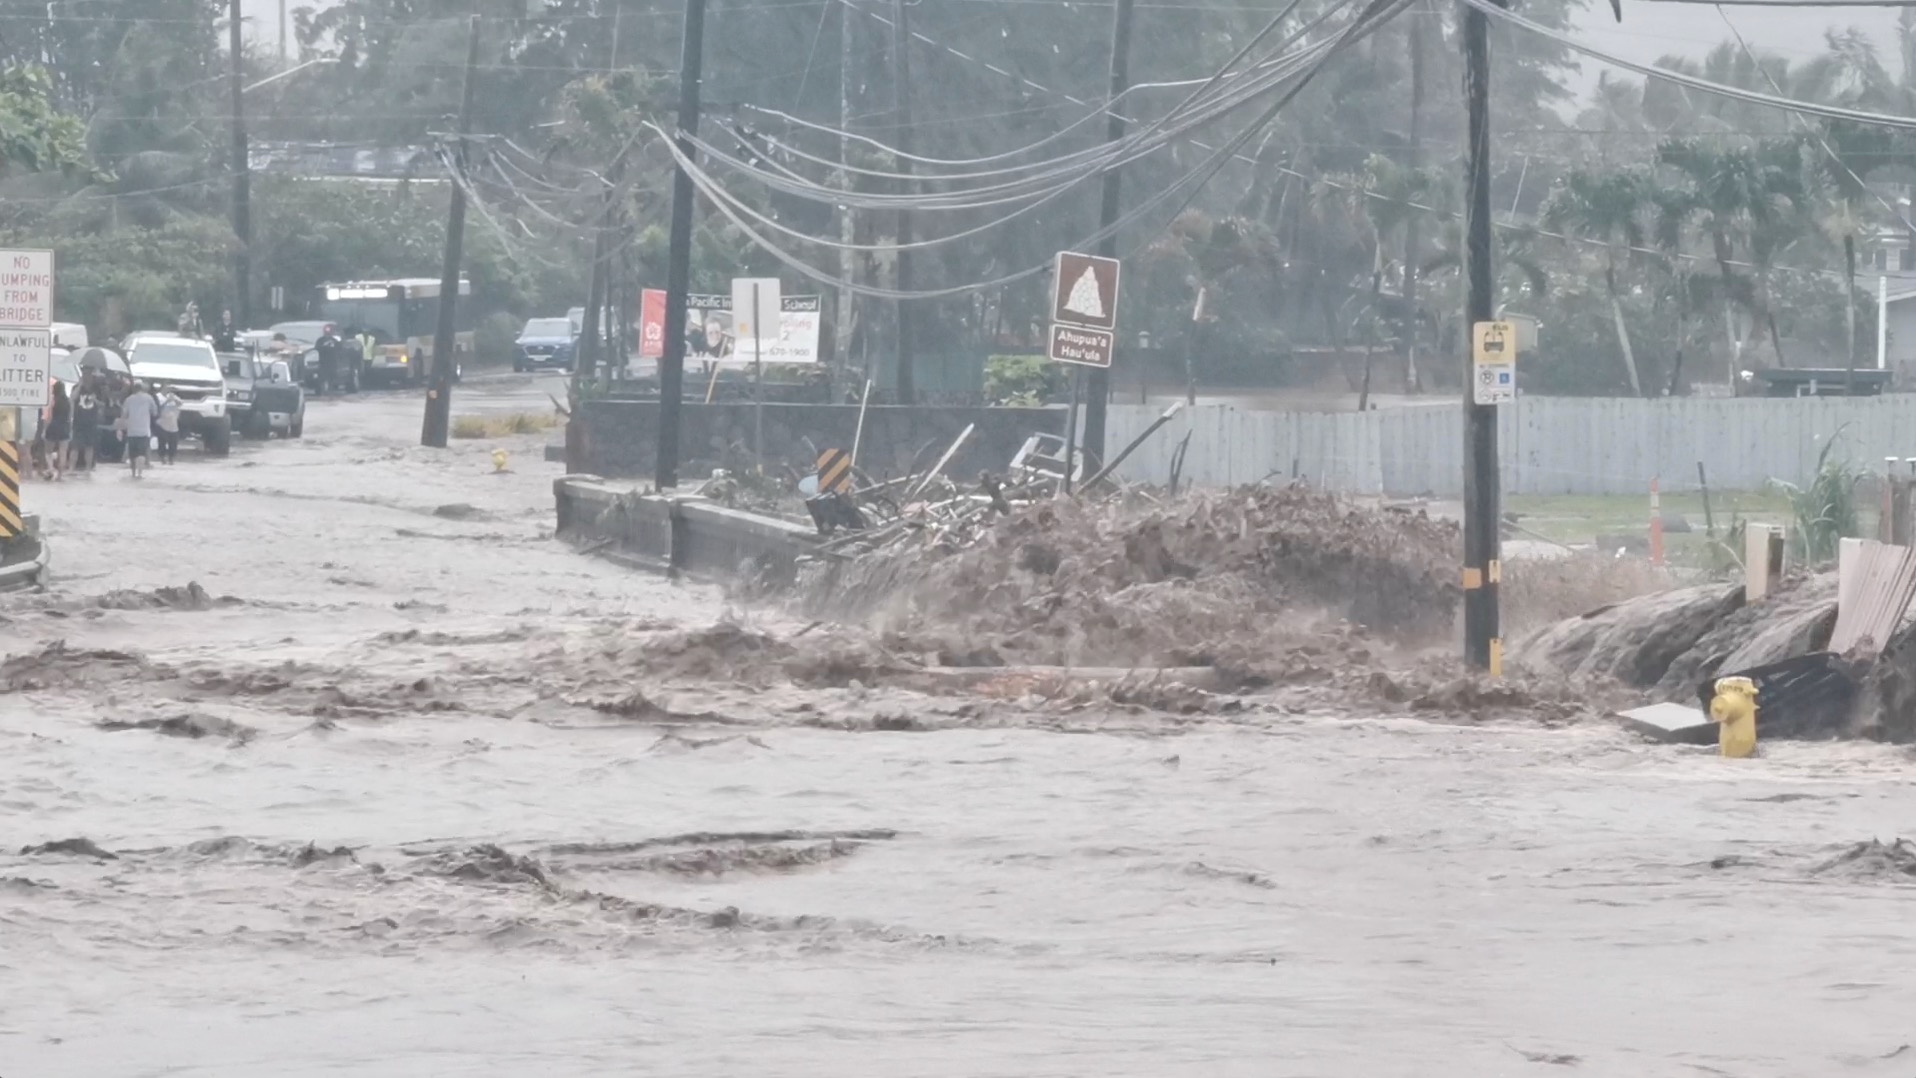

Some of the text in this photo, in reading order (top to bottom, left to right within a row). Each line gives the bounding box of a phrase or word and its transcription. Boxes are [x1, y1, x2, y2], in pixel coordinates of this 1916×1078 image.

[14, 256, 30, 269] NO
[1, 273, 49, 287] UMPING
[5, 290, 38, 303] FROM
[691, 297, 721, 308] Pacific
[784, 299, 817, 310] School
[0, 307, 43, 321] BRIDGE
[0, 336, 48, 349] NLAWFUL
[1058, 330, 1107, 347] Ahupua'a
[13, 353, 27, 363] TO
[1061, 345, 1101, 361] Hau'ula
[0, 368, 44, 382] ITTER
